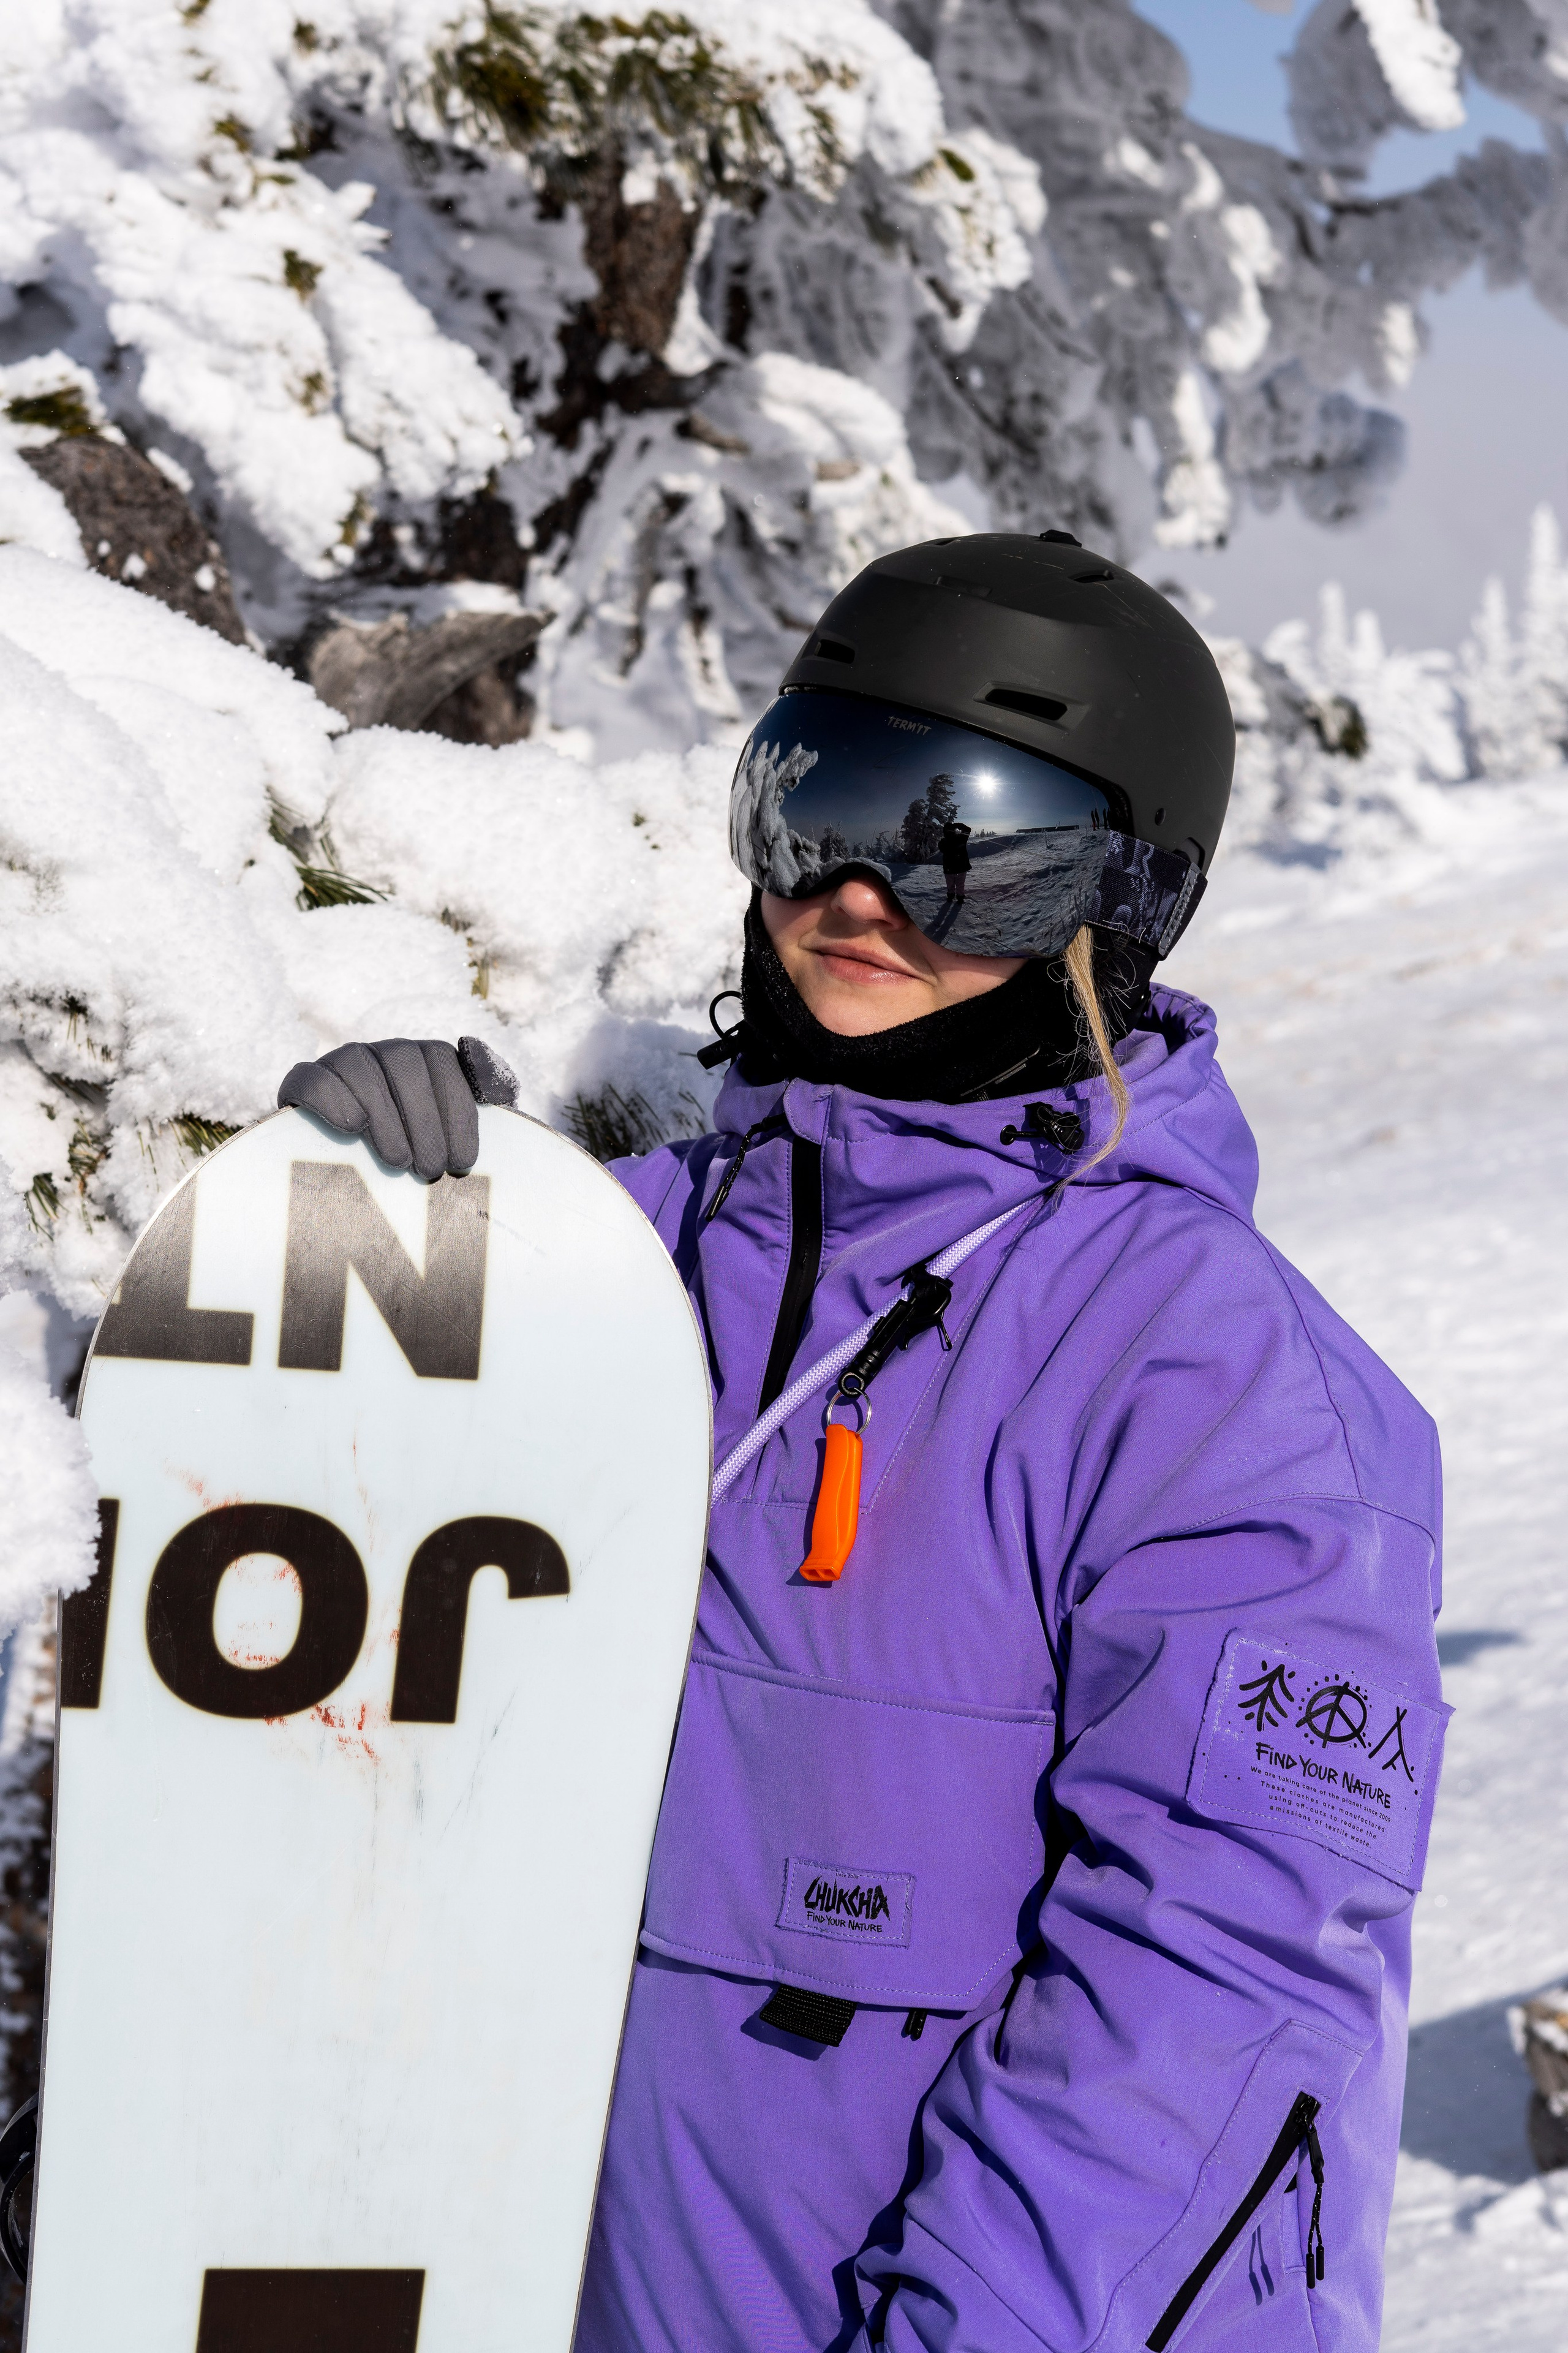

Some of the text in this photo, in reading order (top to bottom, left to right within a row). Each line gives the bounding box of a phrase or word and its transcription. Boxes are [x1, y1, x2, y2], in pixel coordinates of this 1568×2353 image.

[1251, 1766, 1262, 1774] We
[1278, 1775, 1300, 1788] taking
[1302, 1784, 1317, 1792] care
[1342, 1797, 1362, 1809] planet
[1363, 1806, 1378, 1816] since
[1379, 1812, 1391, 1823] 2009
[1298, 1754, 1339, 1785] YOUR
[1342, 1771, 1391, 1809] NATURE
[1261, 1780, 1385, 1832] These clothes are manufactured
[1268, 1794, 1292, 1805] using
[1296, 1802, 1327, 1817] off-cuts
[1341, 1819, 1363, 1833] reduce
[1366, 1830, 1377, 1839] the
[1269, 1805, 1311, 1821] emissions
[1325, 1823, 1348, 1837] textile
[1351, 1835, 1371, 1848] waste.
[804, 1875, 891, 1921] CHUKCHA
[826, 1915, 846, 1927] YOUR
[848, 1919, 883, 1933] NATURE
